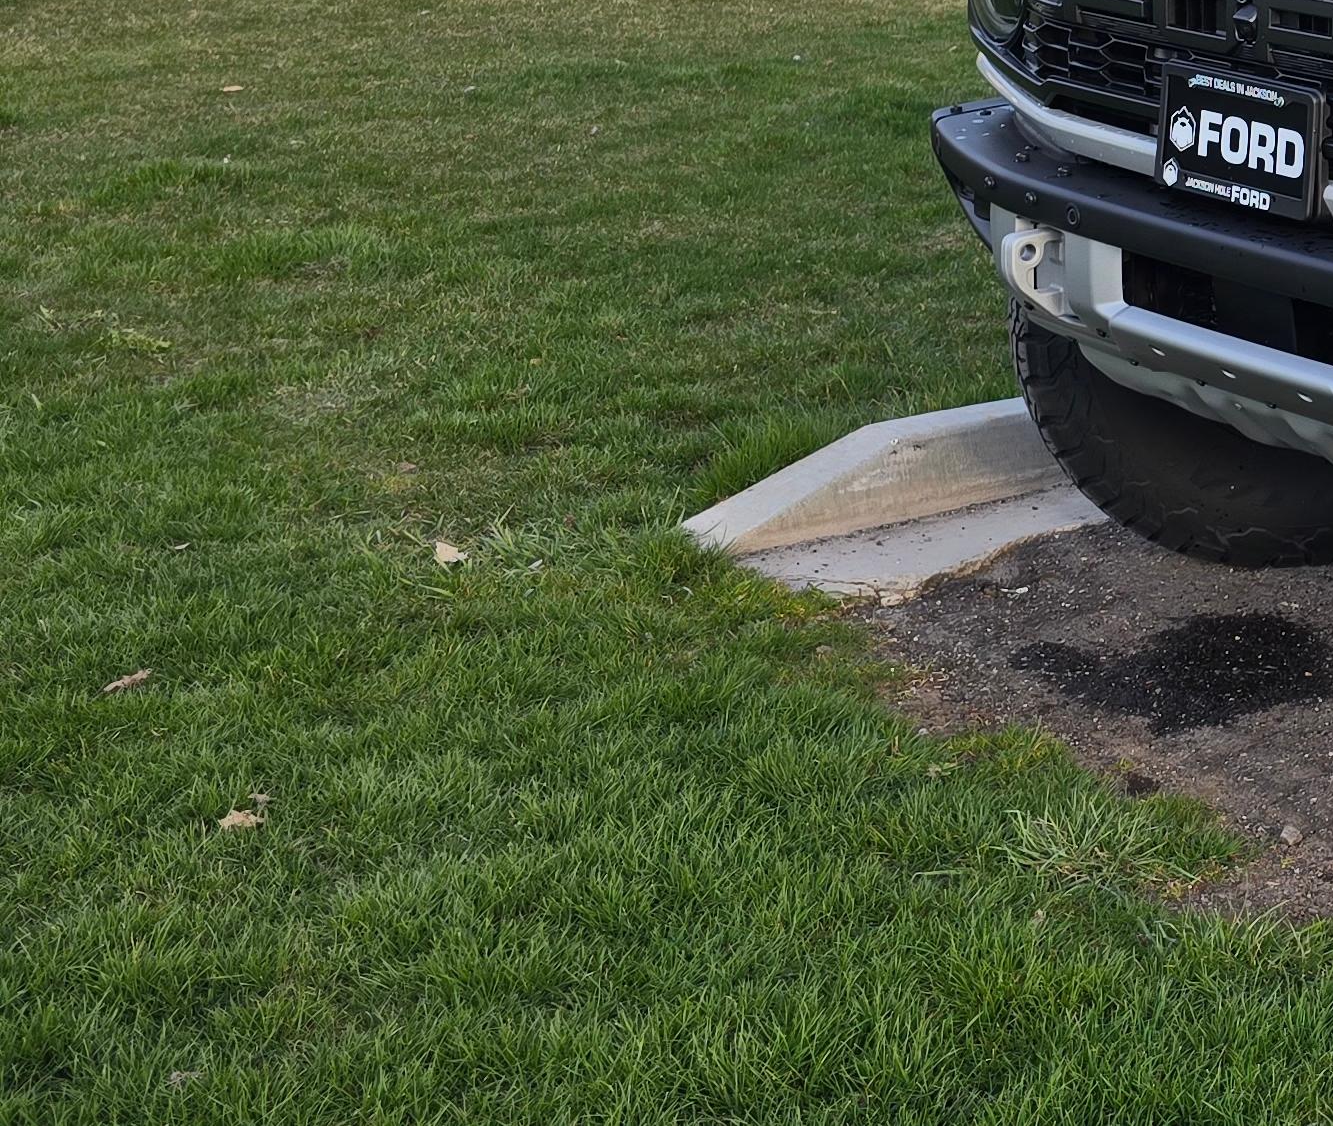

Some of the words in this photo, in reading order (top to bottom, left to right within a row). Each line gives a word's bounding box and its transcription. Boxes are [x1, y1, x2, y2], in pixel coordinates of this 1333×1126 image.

[1195, 74, 1213, 88] BEST
[1213, 78, 1236, 92] DEALS
[1236, 82, 1245, 95] IN
[1245, 85, 1278, 102] JACKSON
[1198, 109, 1304, 179] FORD
[1185, 176, 1215, 194] JACKSON
[1214, 183, 1232, 198] HOLE
[1230, 184, 1271, 211] FORD
